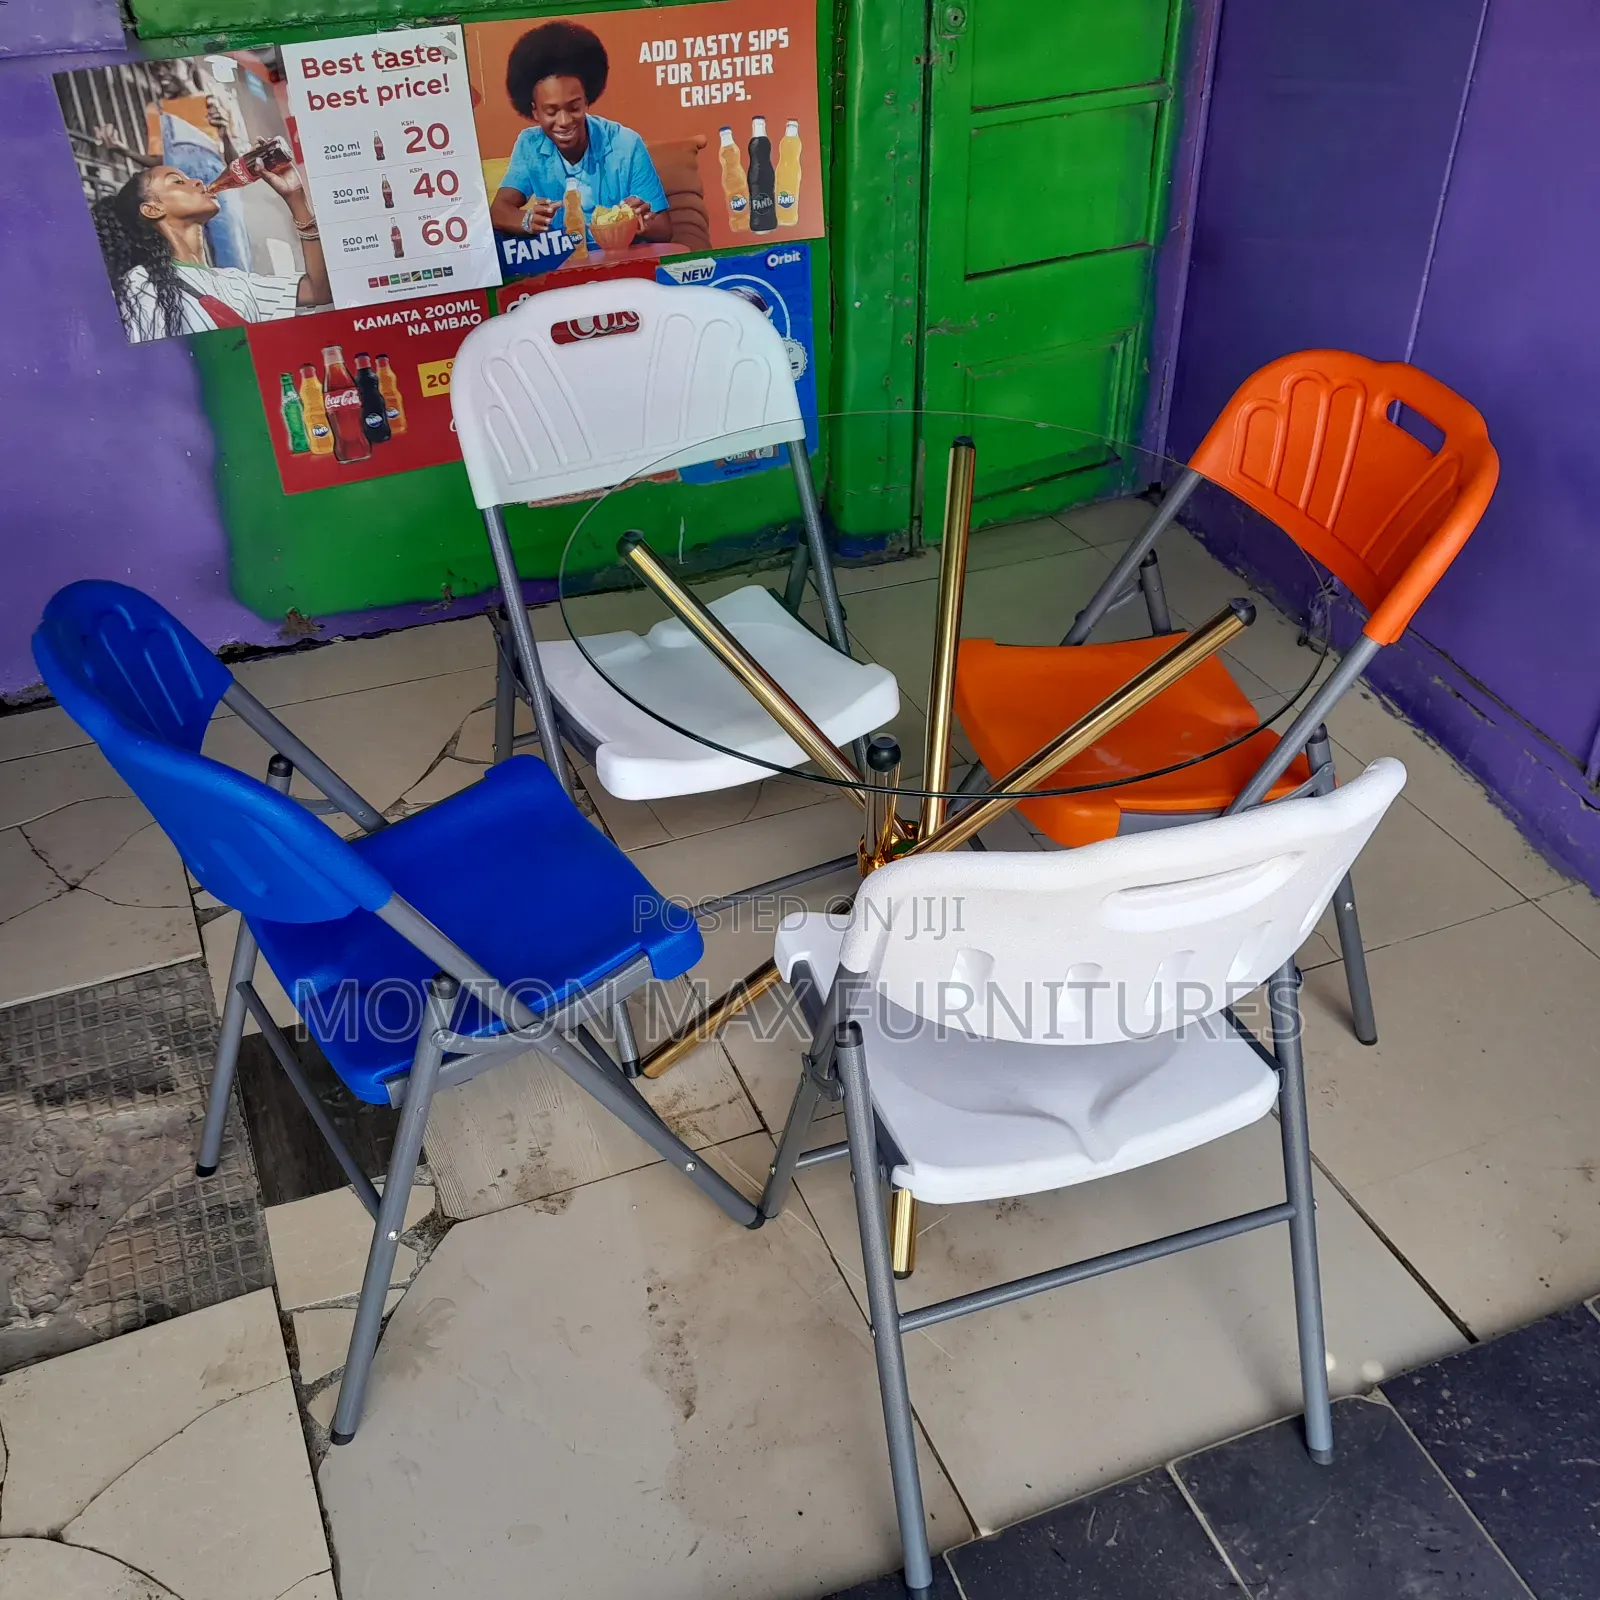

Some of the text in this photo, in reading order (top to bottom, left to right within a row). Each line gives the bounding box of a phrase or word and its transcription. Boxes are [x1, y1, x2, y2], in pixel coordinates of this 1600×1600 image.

[639, 27, 789, 63] ADD TASTY SIPS
[301, 44, 449, 79] Best taste,
[656, 53, 774, 86] FOR TASTIER
[307, 73, 450, 111] best price!
[680, 80, 751, 107] CRISPS.
[324, 141, 361, 154] 200 ml
[404, 122, 450, 154] 20
[332, 186, 369, 199] 300 ml
[413, 169, 459, 198] 40
[342, 237, 363, 246] 500
[365, 234, 379, 243] ml
[421, 216, 468, 246] 60
[503, 230, 576, 265] FANTA
[767, 251, 801, 267] Orbit
[682, 266, 713, 282] NEW
[353, 299, 480, 332] KAMATA 200ML
[407, 312, 482, 337] NA MBAO
